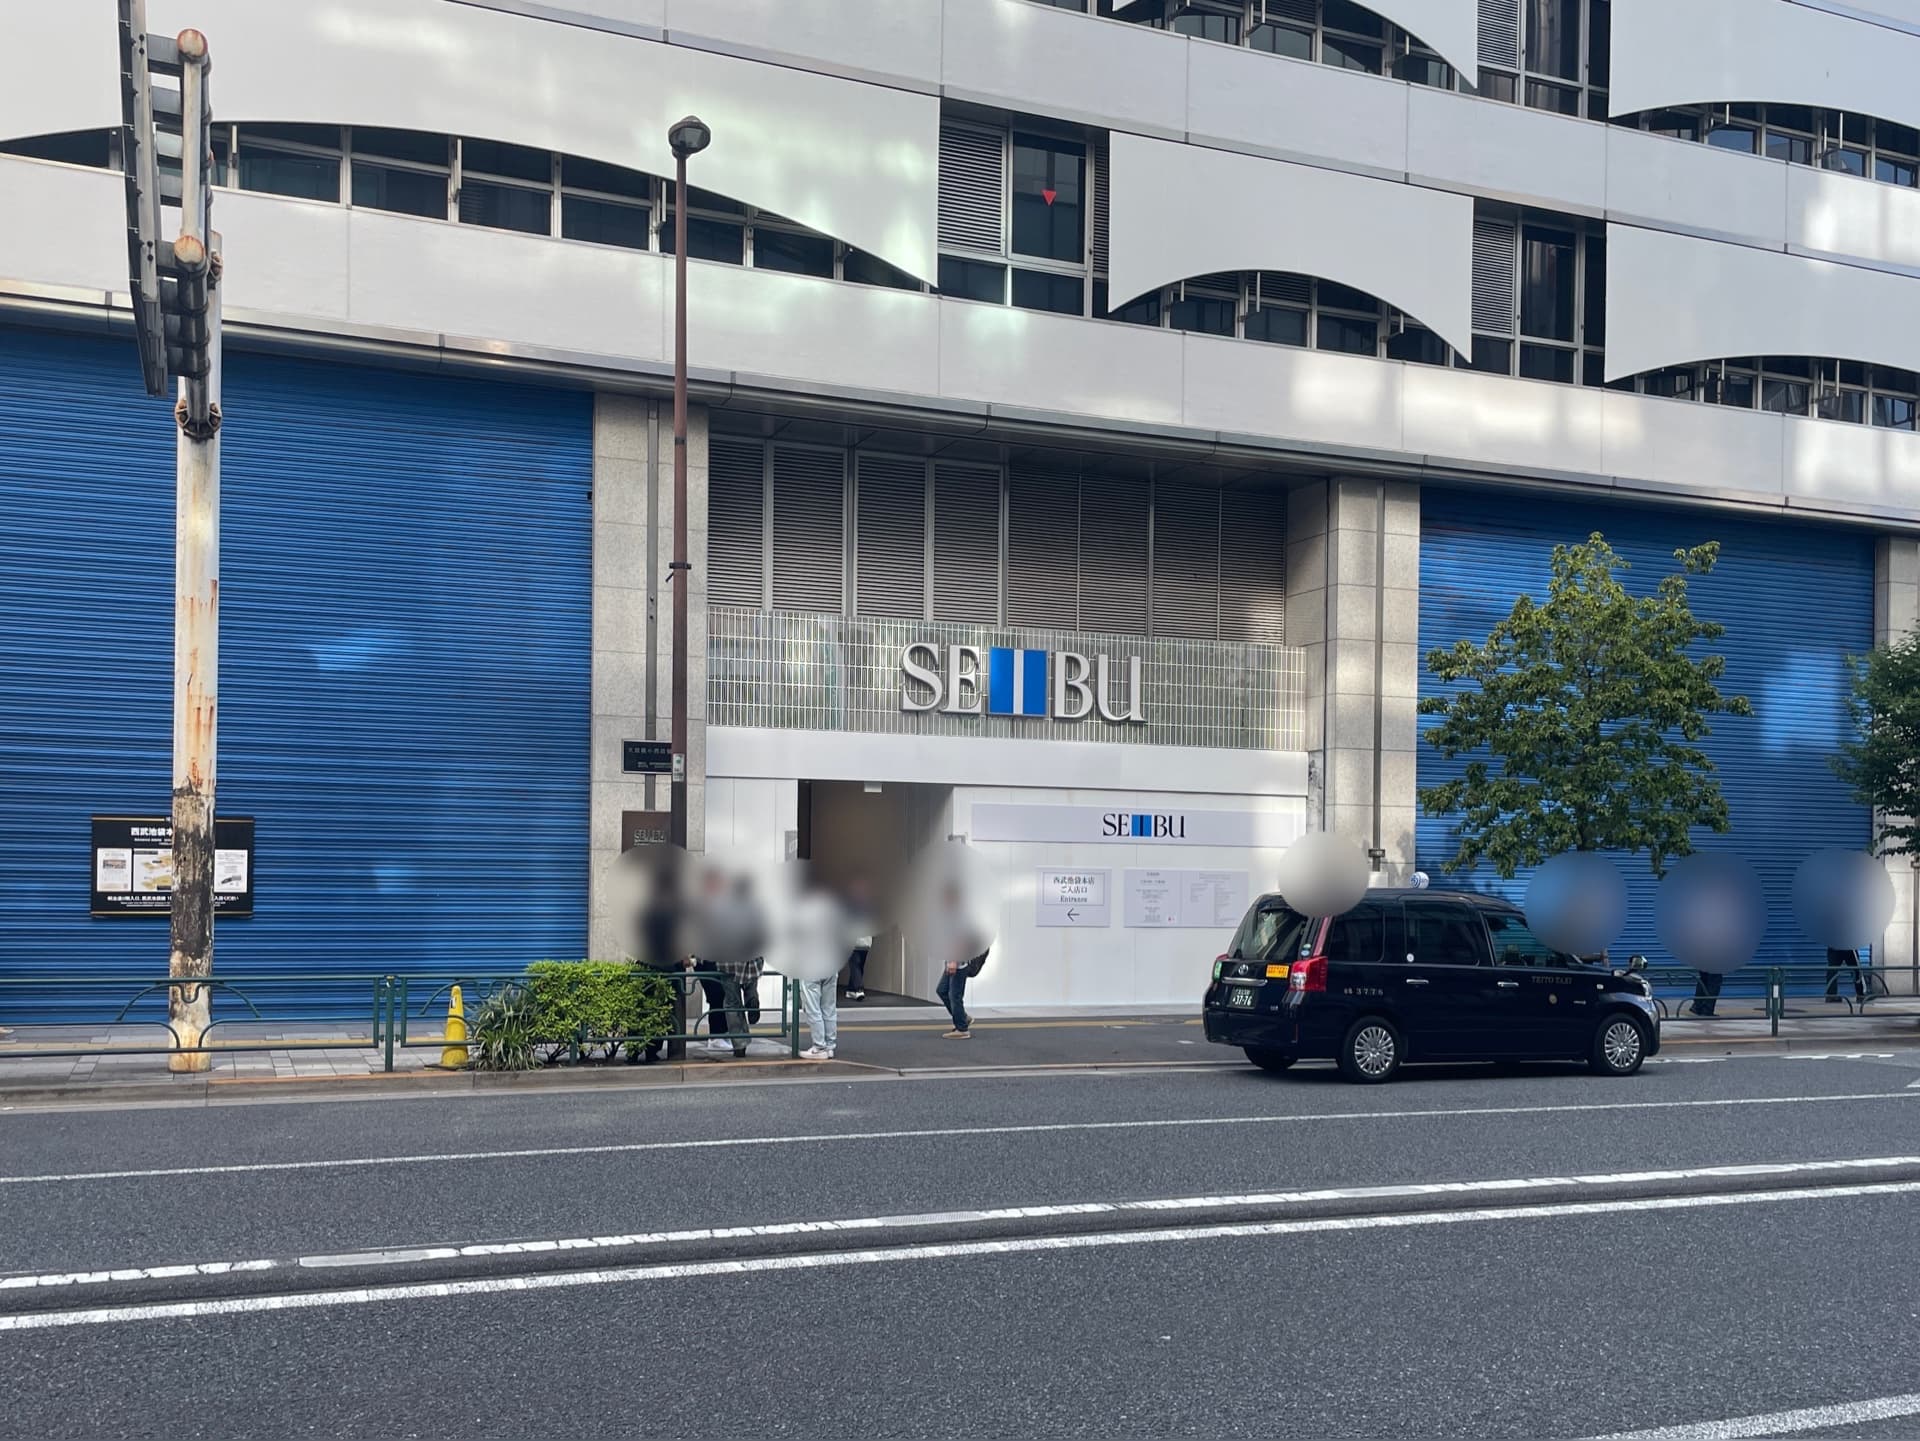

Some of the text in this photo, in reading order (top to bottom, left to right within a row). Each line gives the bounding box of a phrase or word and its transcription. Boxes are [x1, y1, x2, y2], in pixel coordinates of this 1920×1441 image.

[900, 642, 1147, 723] SEIBU
[1102, 813, 1185, 838] SEIBU
[1053, 876, 1095, 886] 西武池袋本店
[1060, 885, 1088, 894] ご入店口
[1060, 895, 1088, 903] Entrance
